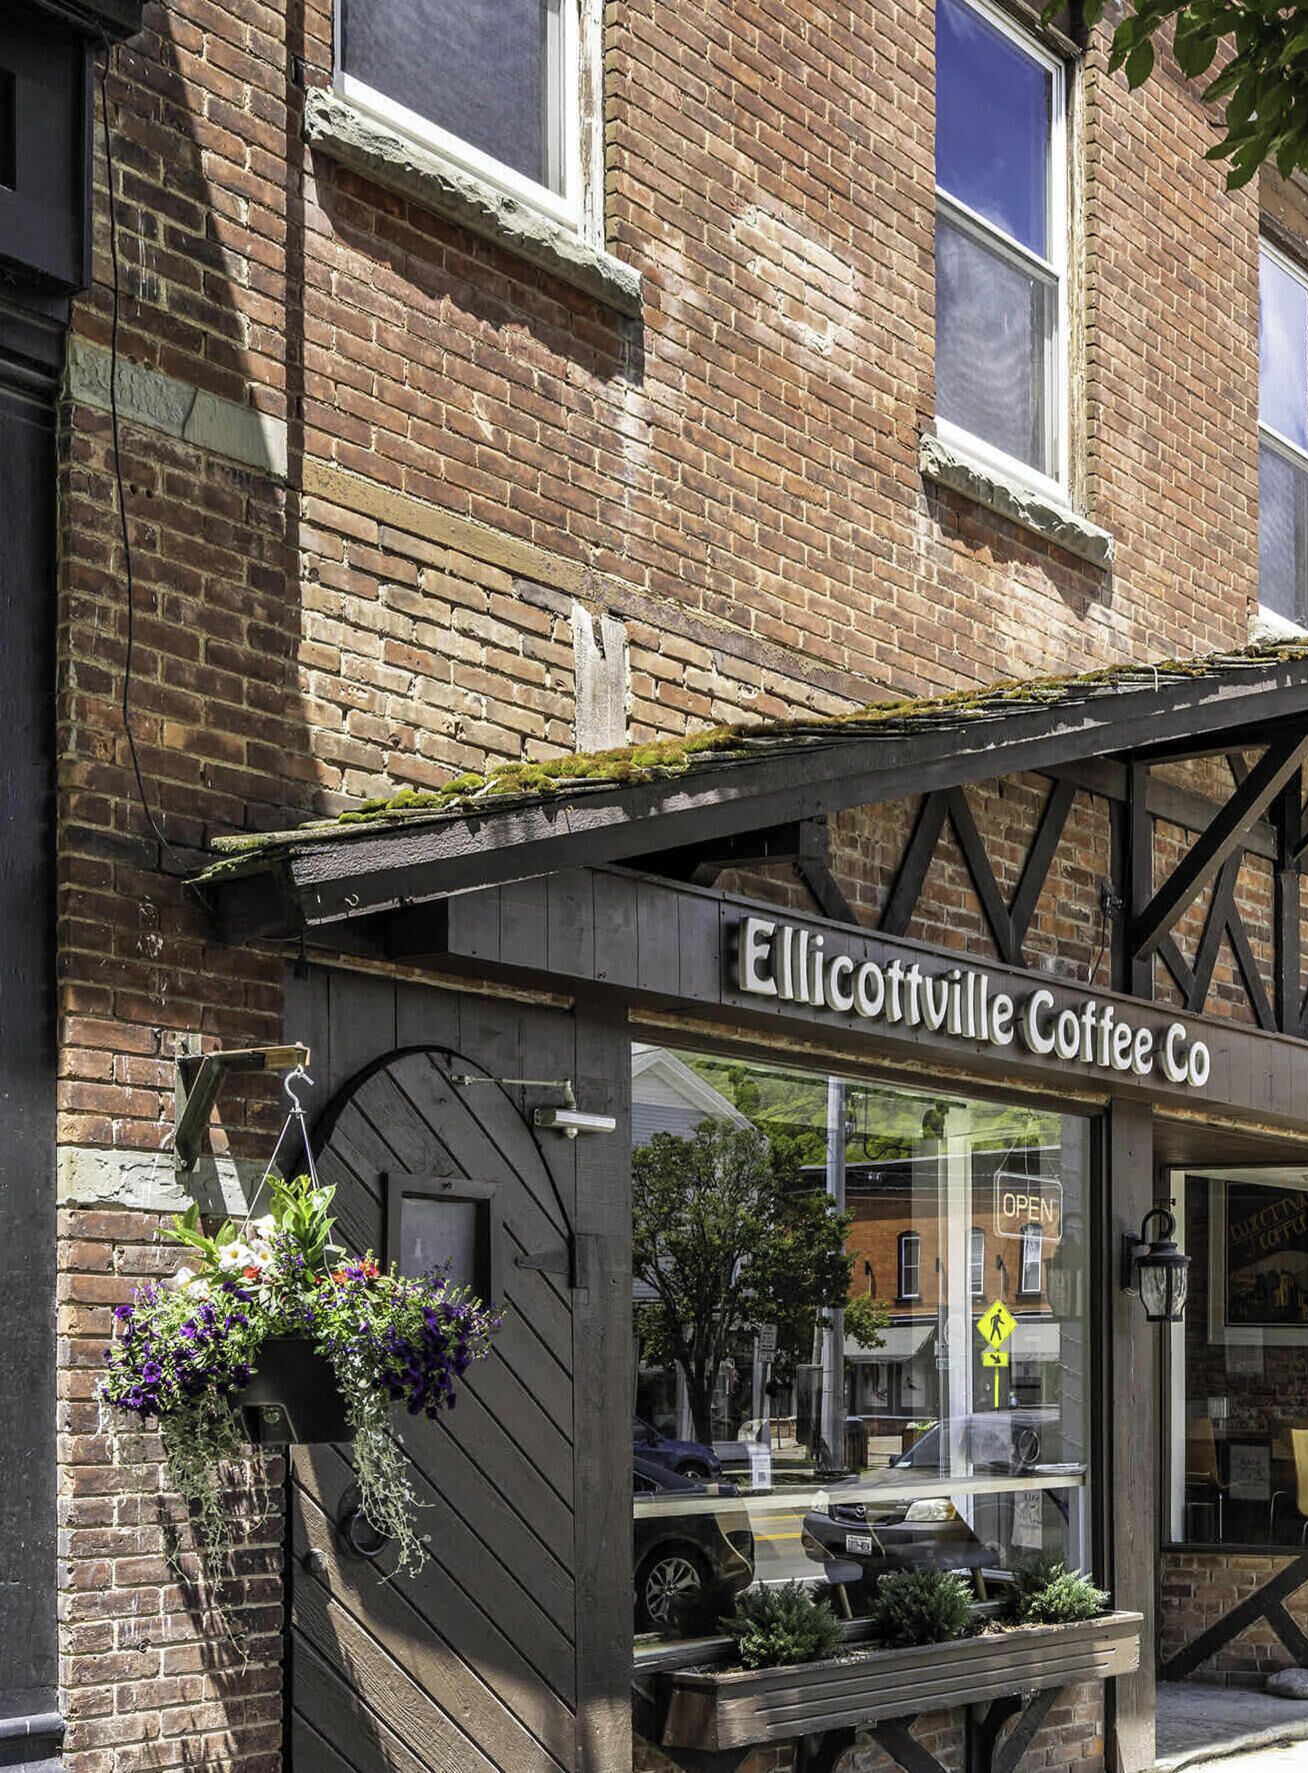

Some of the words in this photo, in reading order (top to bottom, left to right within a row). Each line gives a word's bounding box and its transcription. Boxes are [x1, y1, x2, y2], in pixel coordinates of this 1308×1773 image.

[739, 917, 1014, 1046] Ellicottville
[1023, 989, 1154, 1075] Coffee
[1161, 1022, 1211, 1087] Co
[1003, 1193, 1055, 1222] OPEN
